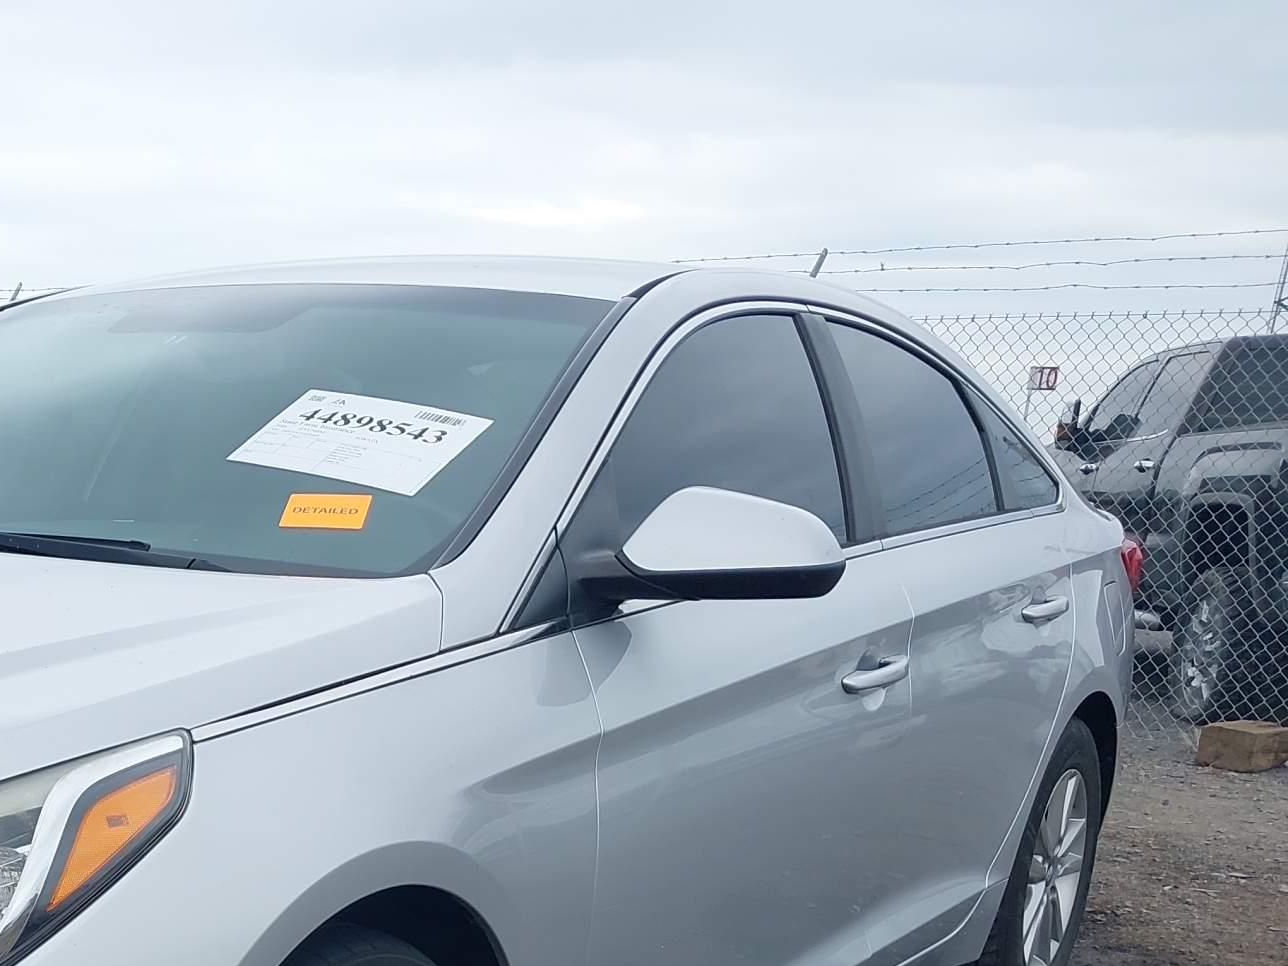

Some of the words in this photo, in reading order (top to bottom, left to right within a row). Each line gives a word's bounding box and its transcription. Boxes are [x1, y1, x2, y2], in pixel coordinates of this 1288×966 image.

[1037, 369, 1058, 388] 10
[299, 409, 447, 443] 44898543
[292, 506, 359, 515] DETAILED
